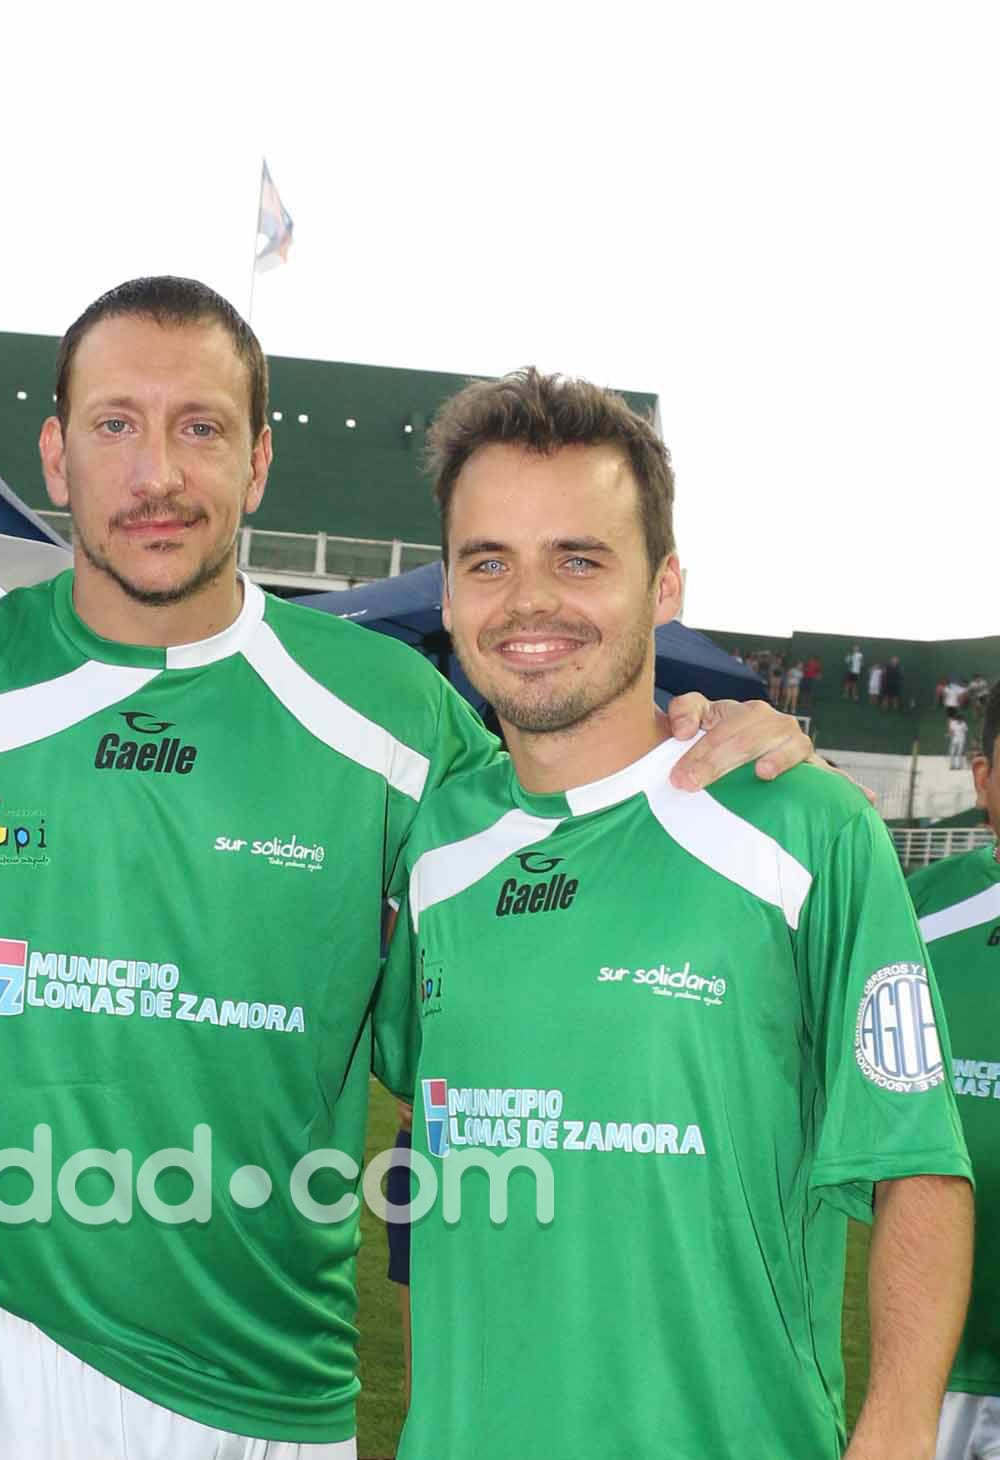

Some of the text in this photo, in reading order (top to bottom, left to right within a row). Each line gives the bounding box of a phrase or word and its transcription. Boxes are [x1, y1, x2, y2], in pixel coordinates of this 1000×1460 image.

[94, 733, 198, 775] Gaelle
[214, 834, 325, 862] sur solidario
[495, 873, 579, 917] Gaelle
[28, 951, 180, 991] MUNICIPIO
[597, 964, 629, 983] sur
[632, 962, 727, 997] solidario
[27, 978, 305, 1033] LOMAS DE ZAMORA
[448, 1087, 563, 1120] MUNICIPIO
[450, 1117, 706, 1155] LOMAS DE ZAMORA
